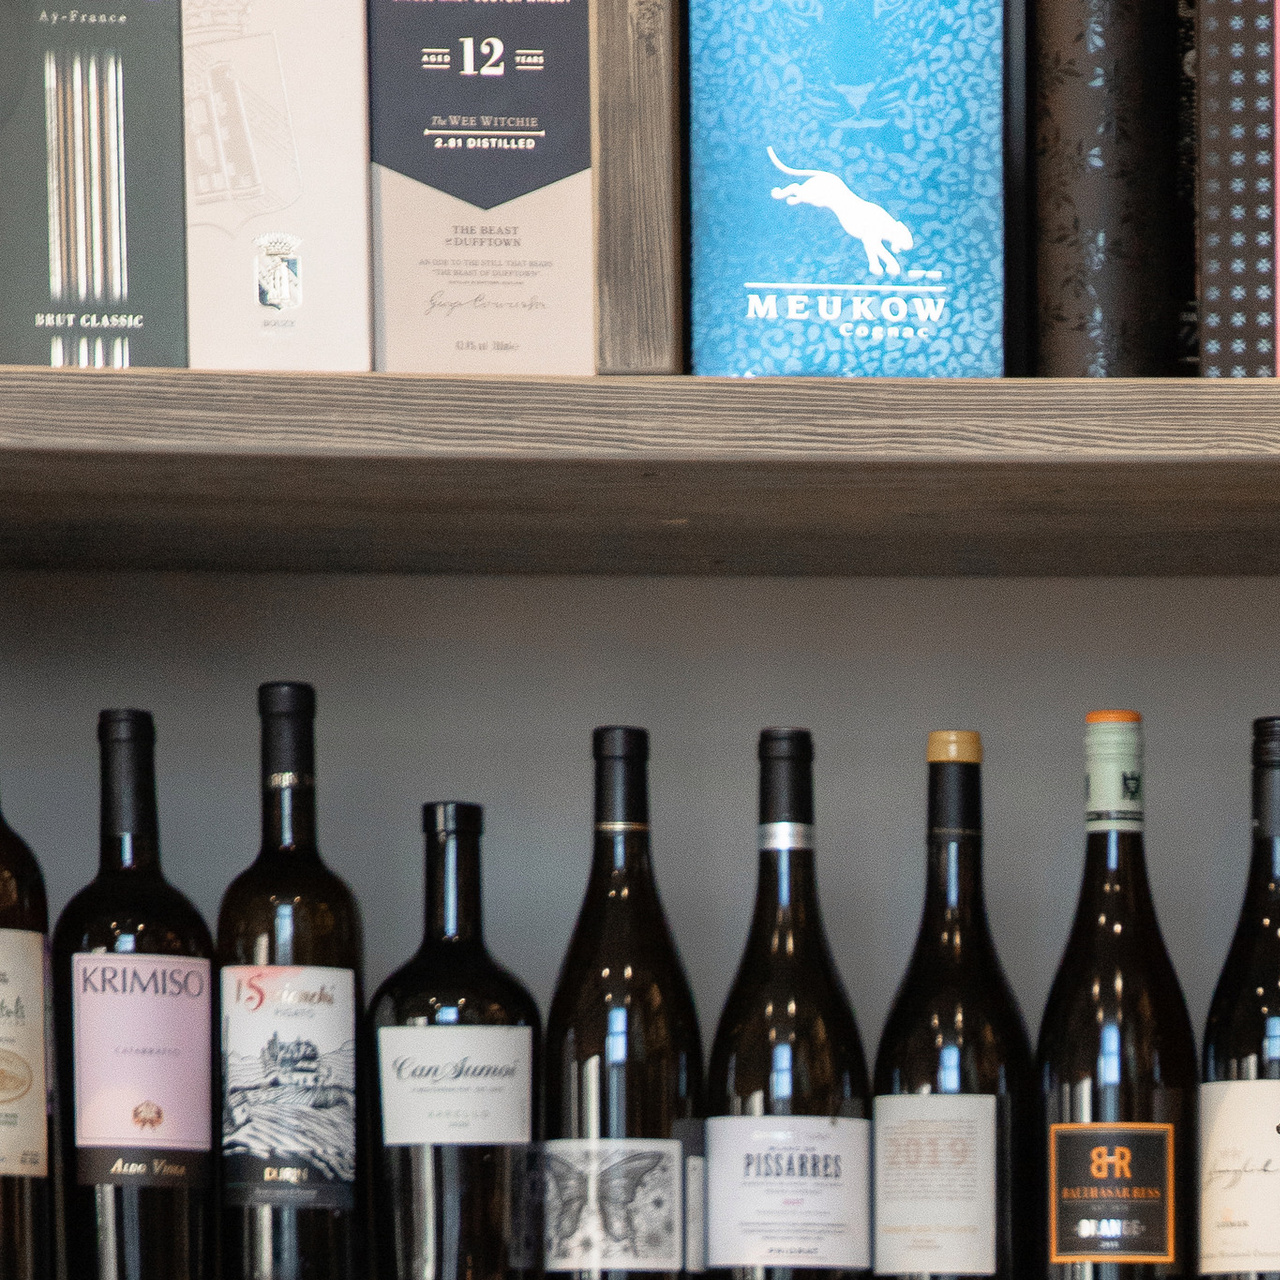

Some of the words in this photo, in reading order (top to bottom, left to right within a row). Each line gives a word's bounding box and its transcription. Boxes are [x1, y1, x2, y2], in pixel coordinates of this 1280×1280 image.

[421, 54, 451, 63] AGED
[458, 36, 505, 76] 12
[515, 55, 544, 64] YEARS
[449, 115, 477, 126] WEE
[480, 115, 539, 127] WITCHIE
[434, 137, 463, 149] 2.81
[467, 137, 536, 150] DISTILLED
[746, 295, 946, 322] MEUKOW
[35, 313, 75, 328] BRUT
[80, 313, 144, 329] CLASSIC
[839, 324, 930, 342] Cognac
[82, 966, 204, 998] KRIMISO
[743, 1151, 842, 1178] PISSARRES
